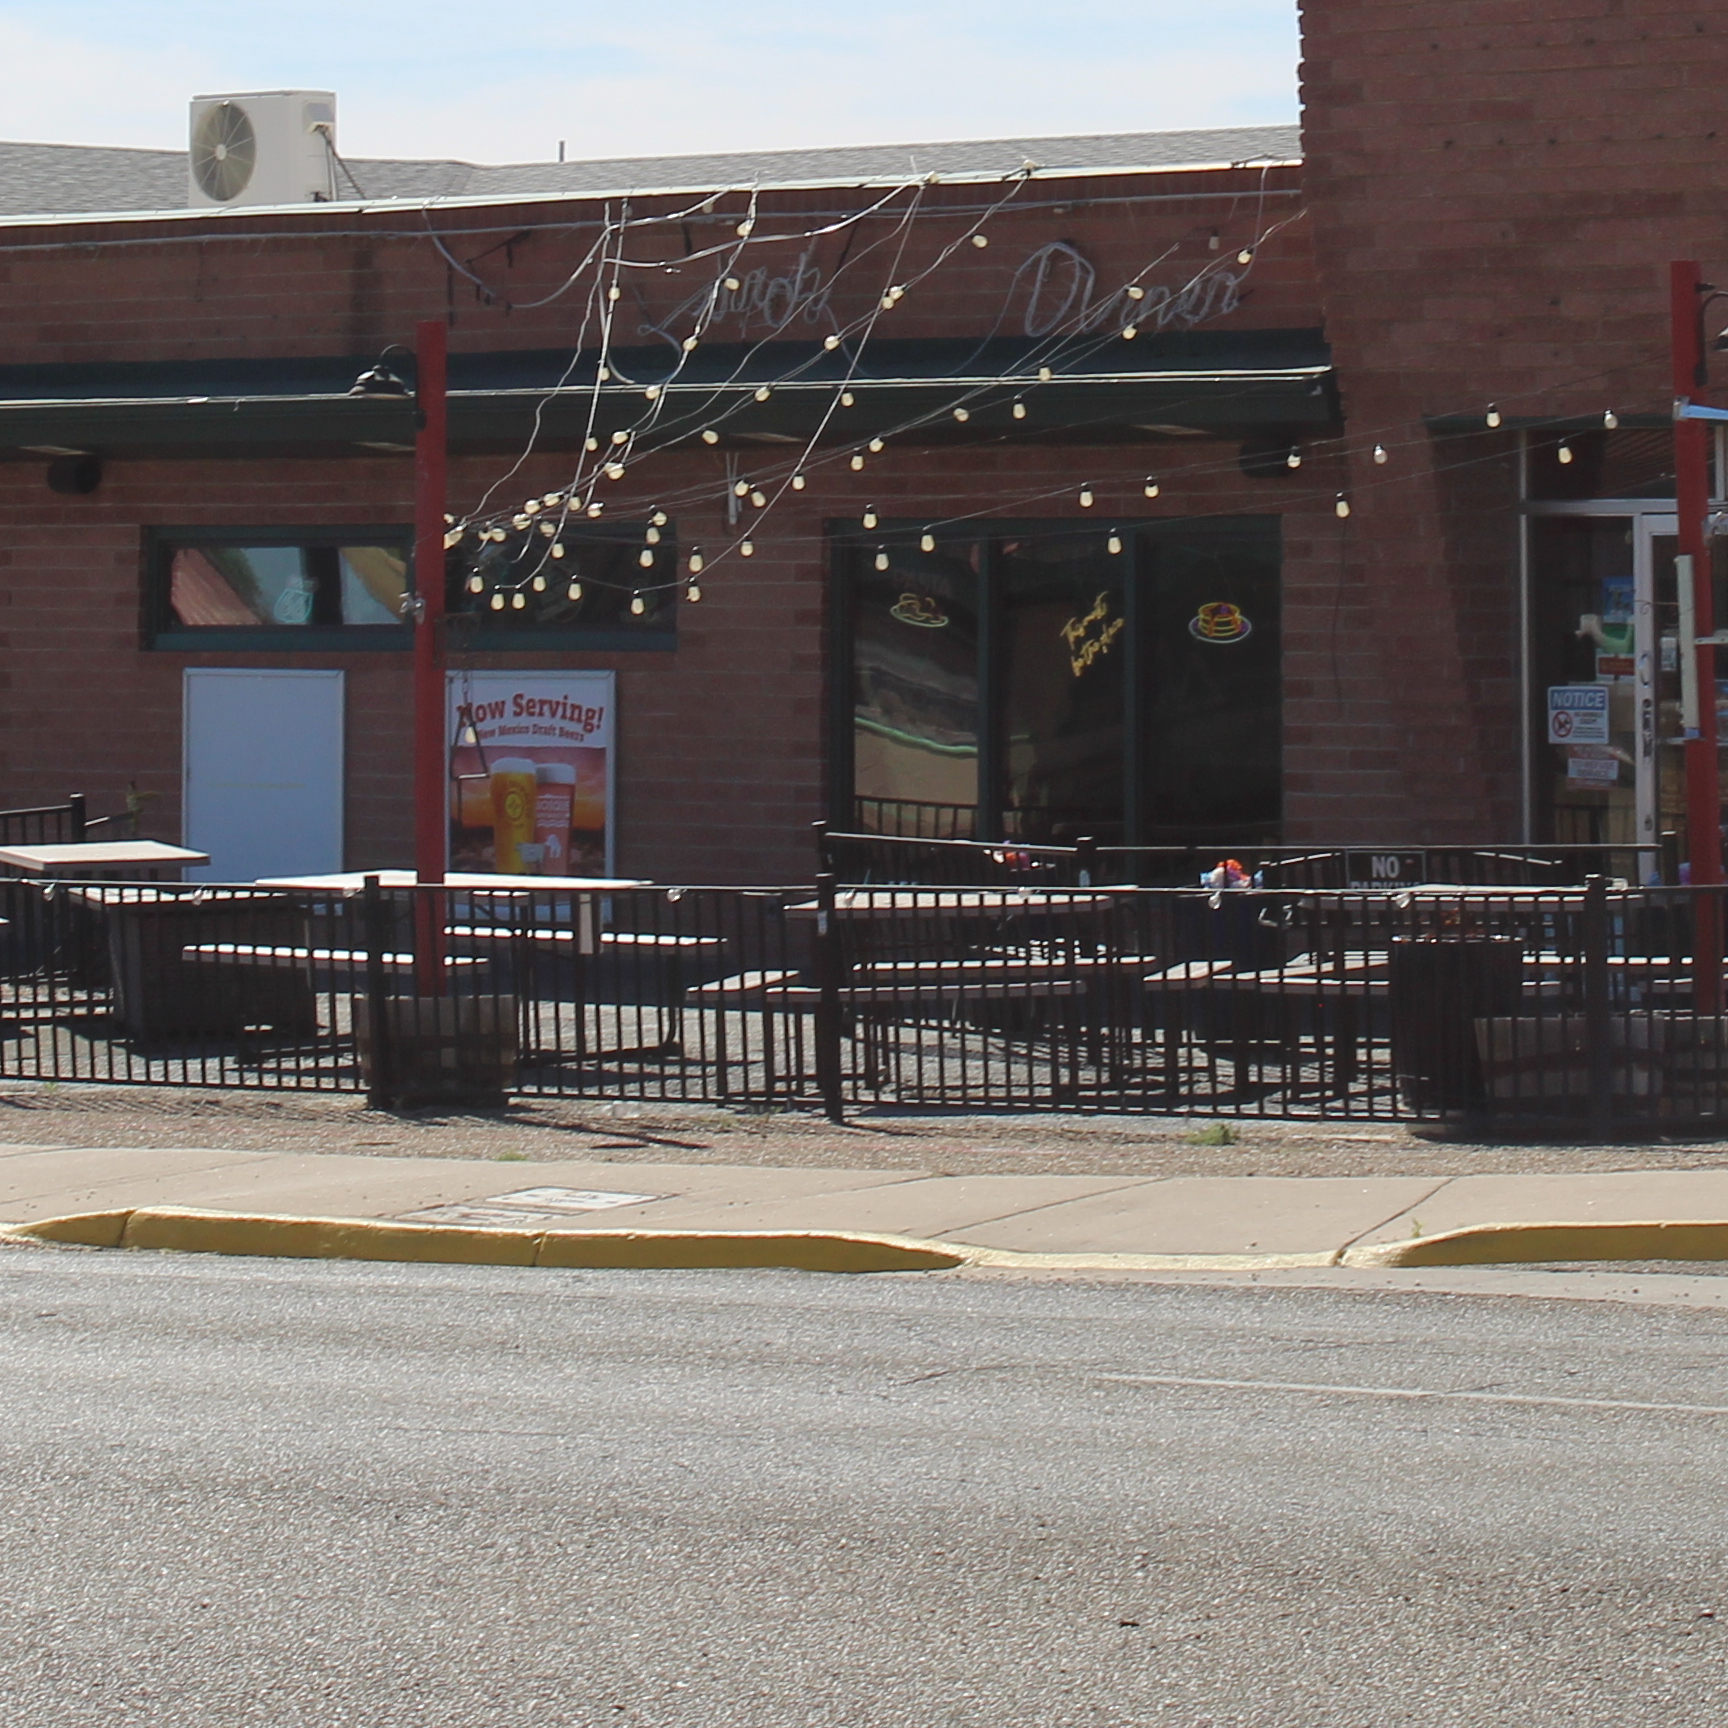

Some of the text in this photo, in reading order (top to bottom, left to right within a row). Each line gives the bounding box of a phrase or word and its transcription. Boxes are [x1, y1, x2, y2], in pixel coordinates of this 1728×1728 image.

[1552, 691, 1605, 708] NOTICE
[512, 692, 605, 734] Serving!
[498, 725, 530, 736] Mexico
[1371, 855, 1401, 879] NO
